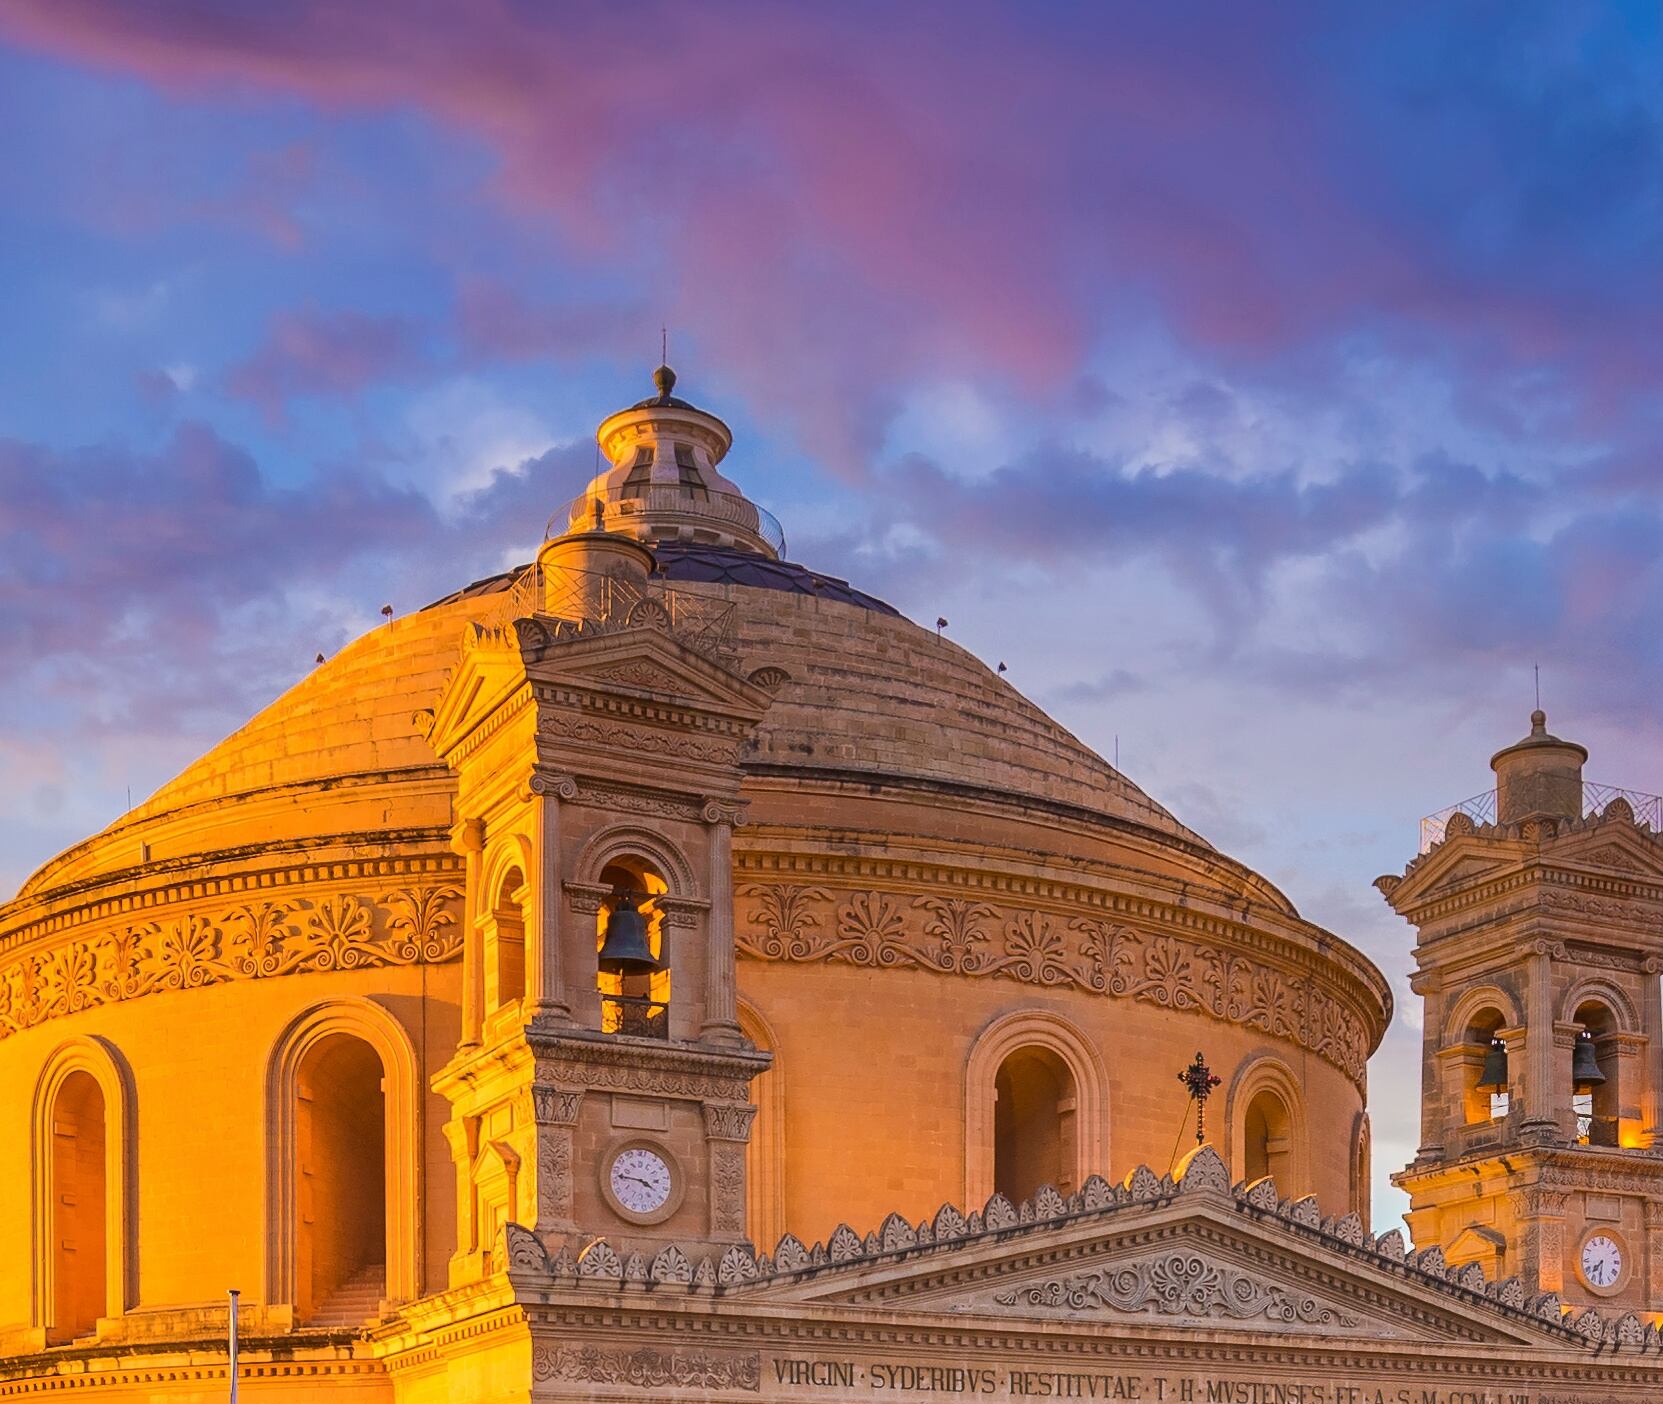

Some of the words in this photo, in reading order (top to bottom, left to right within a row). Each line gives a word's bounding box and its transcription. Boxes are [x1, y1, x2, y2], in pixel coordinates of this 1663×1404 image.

[773, 1359, 855, 1387] VIRGINI
[871, 1365, 996, 1393] SYDERIBVS
[1009, 1371, 1141, 1400] RESTITVTAE
[1154, 1378, 1167, 1401] T
[1180, 1379, 1193, 1402] H
